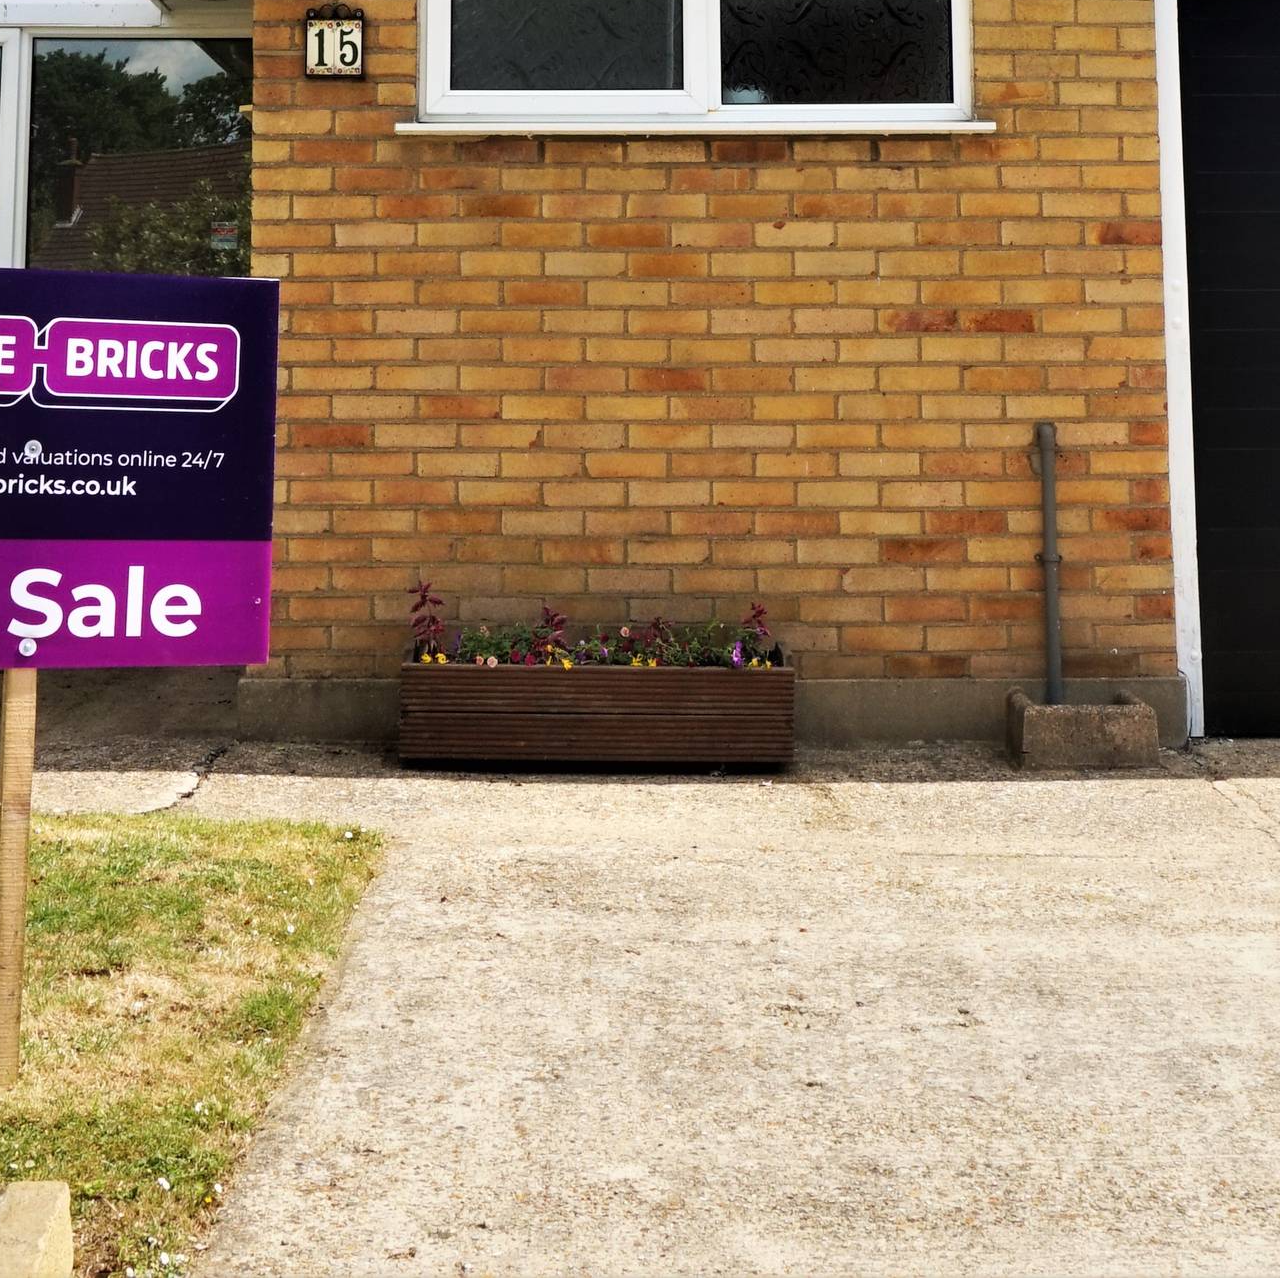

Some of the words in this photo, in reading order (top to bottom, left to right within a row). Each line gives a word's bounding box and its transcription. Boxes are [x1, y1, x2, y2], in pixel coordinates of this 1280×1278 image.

[314, 28, 359, 67] 15
[65, 337, 219, 382] BRICKS
[117, 449, 177, 468] online
[181, 449, 225, 470] 24/7
[7, 565, 202, 639] Sale
